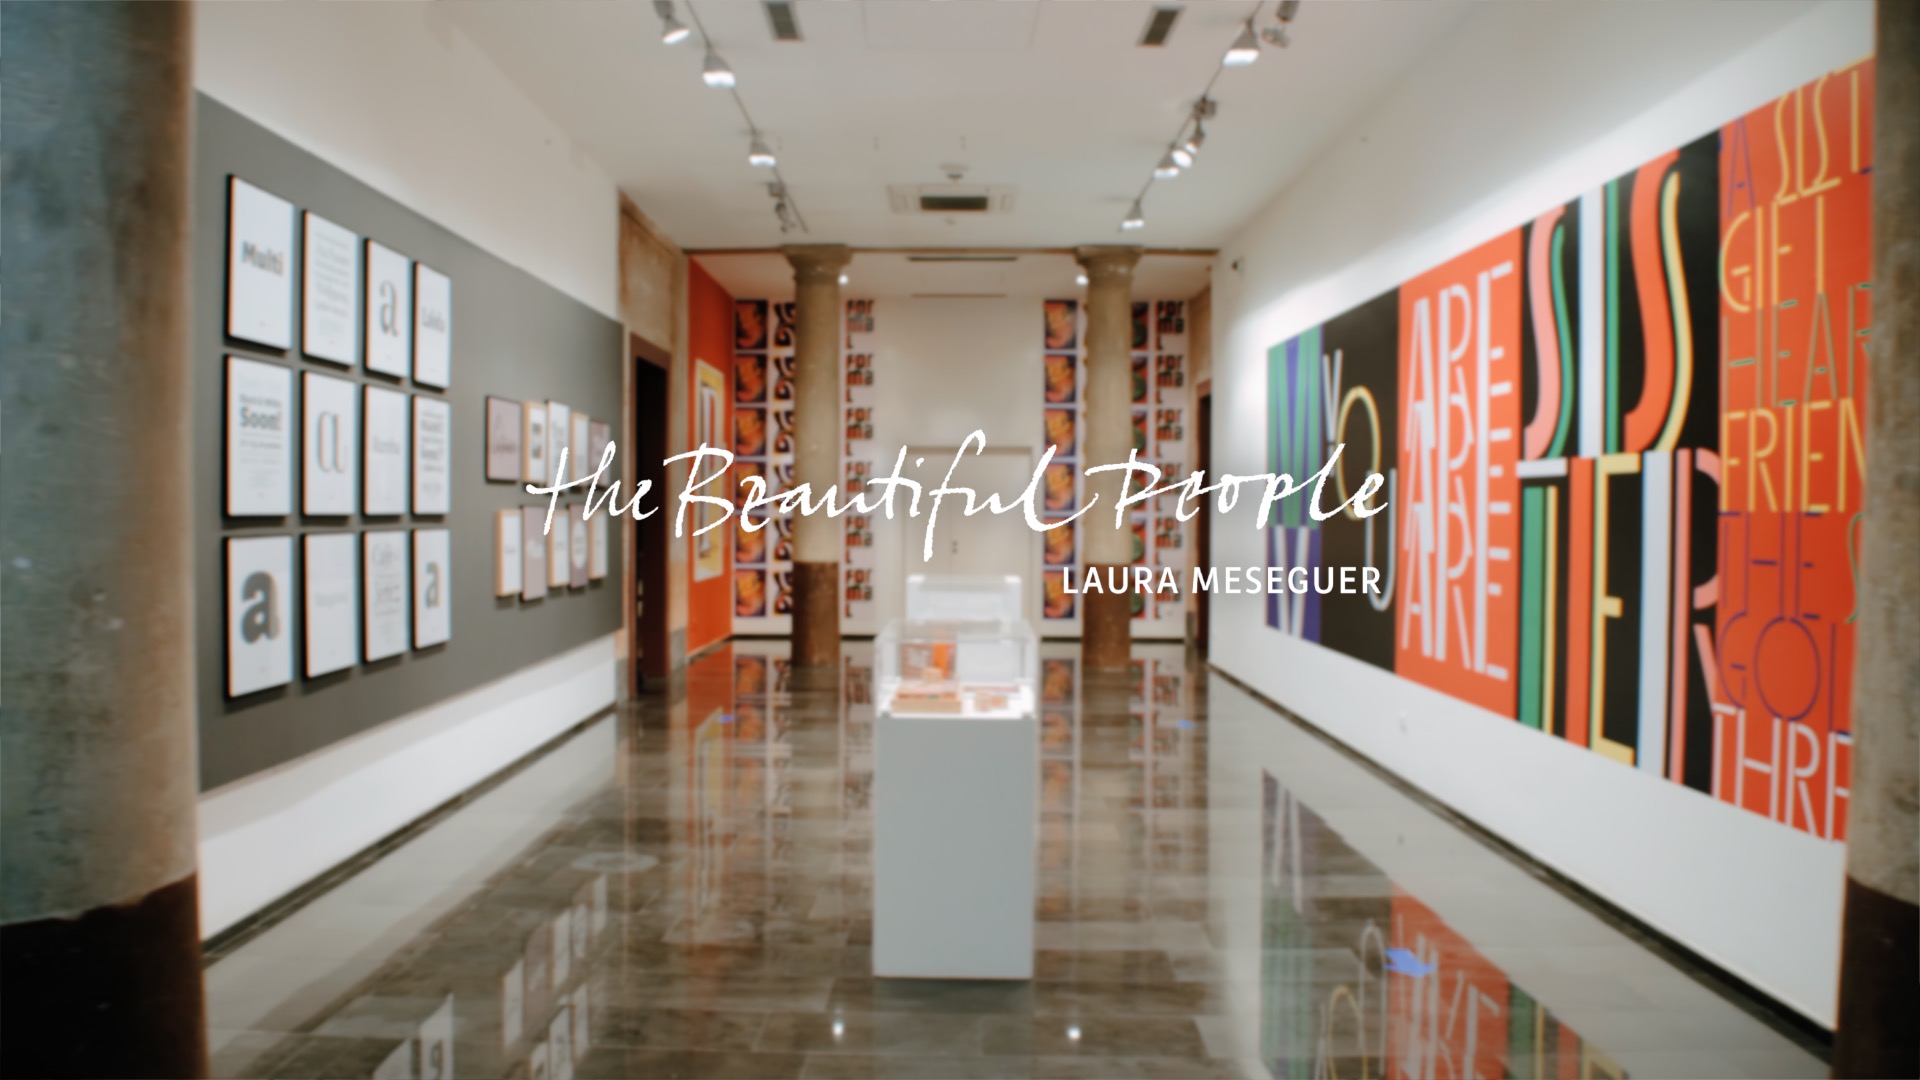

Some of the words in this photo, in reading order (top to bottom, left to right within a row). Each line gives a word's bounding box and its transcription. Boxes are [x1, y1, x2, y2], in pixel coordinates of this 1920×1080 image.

[240, 239, 285, 278] Multi
[240, 569, 282, 647] a
[424, 560, 441, 610] a
